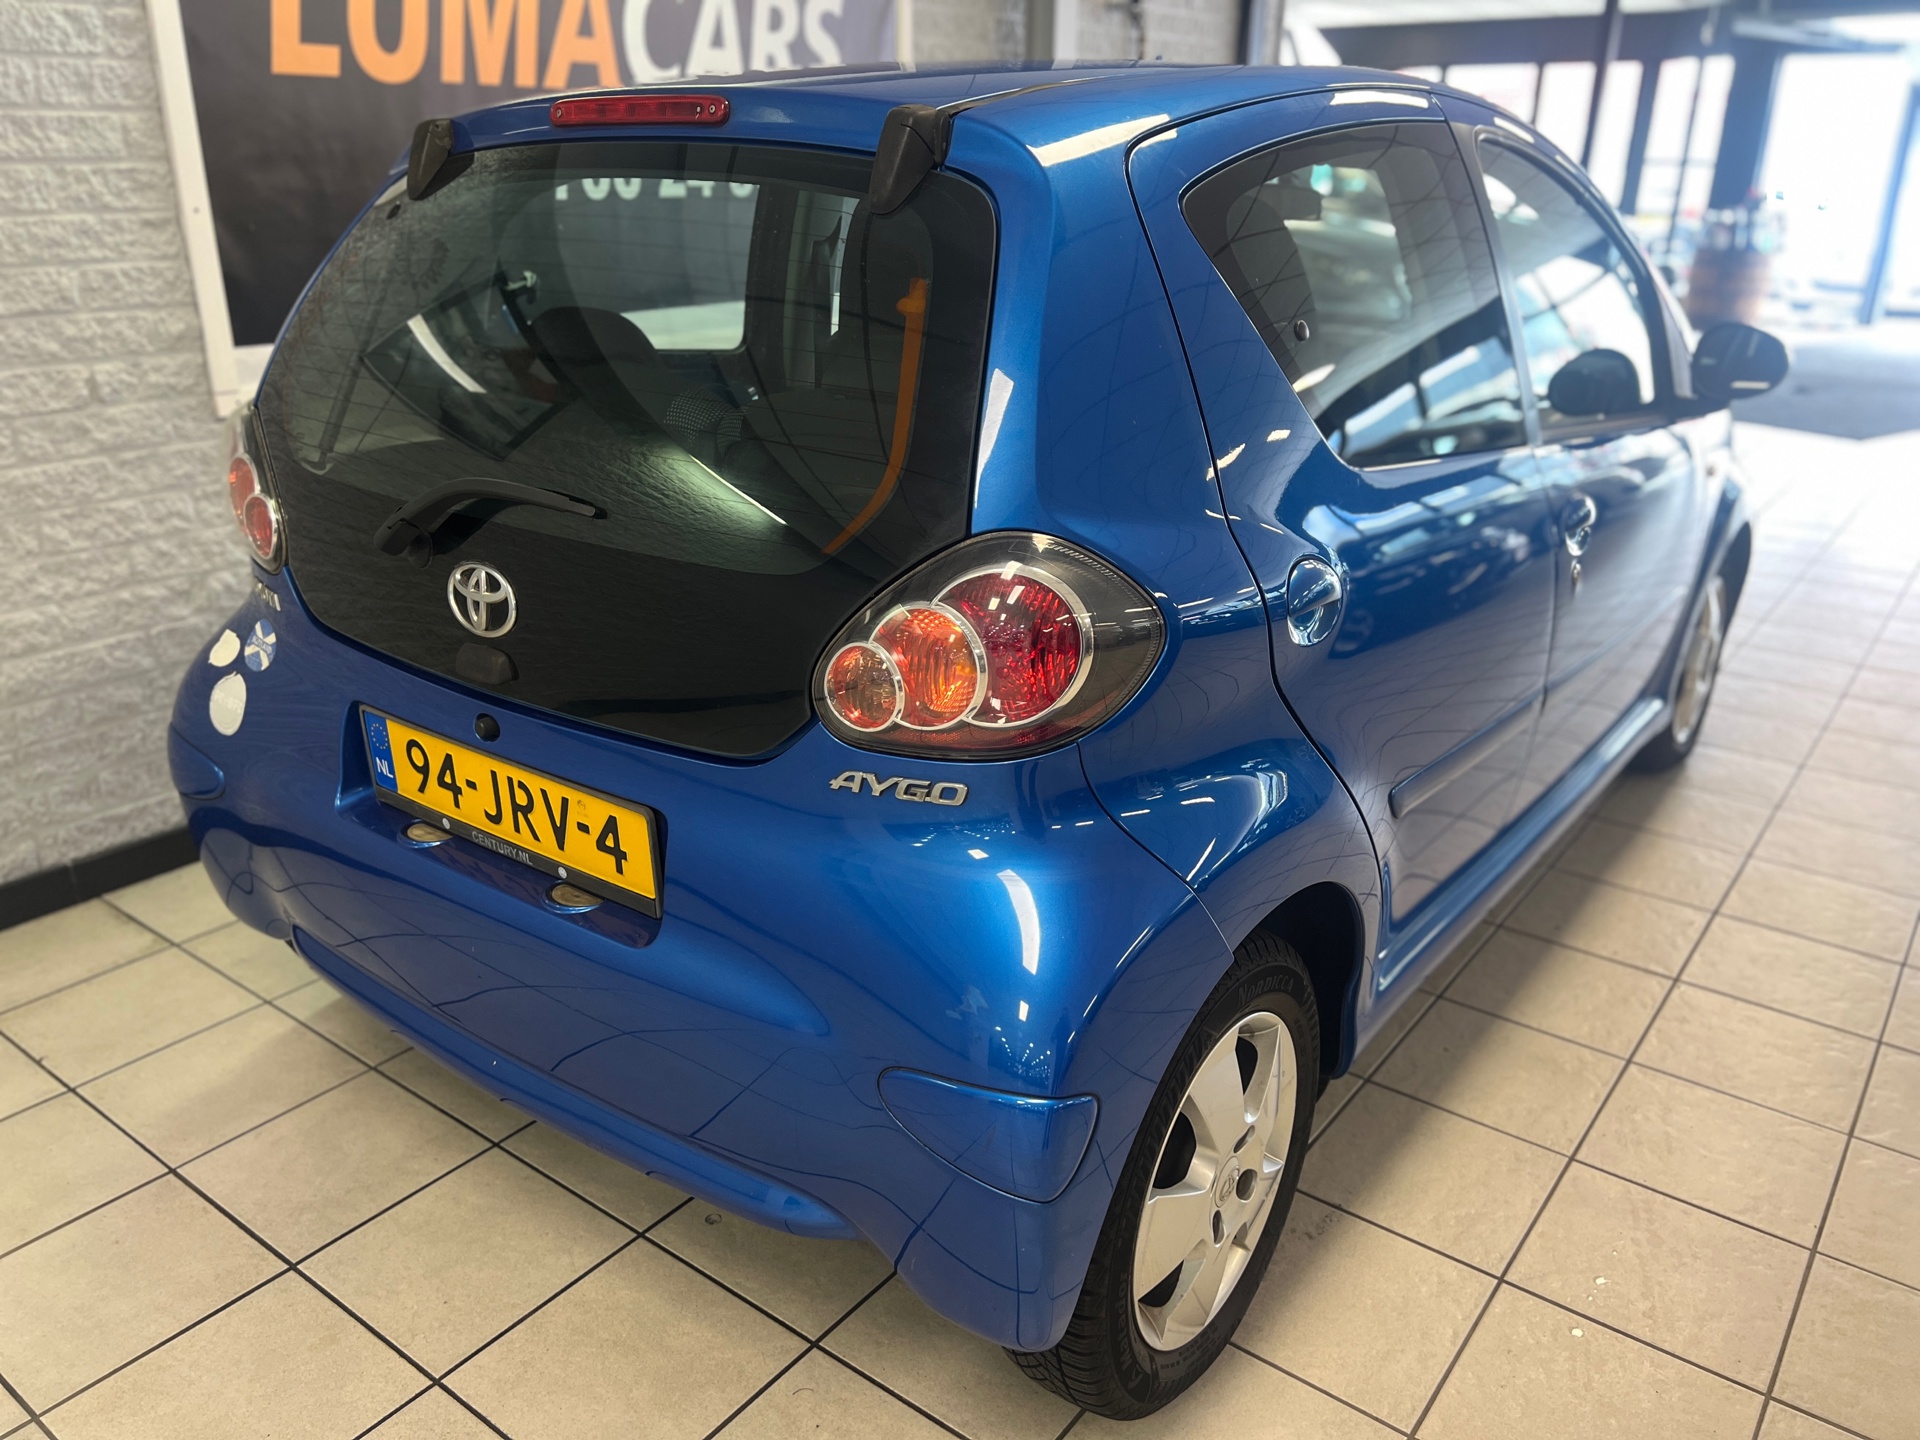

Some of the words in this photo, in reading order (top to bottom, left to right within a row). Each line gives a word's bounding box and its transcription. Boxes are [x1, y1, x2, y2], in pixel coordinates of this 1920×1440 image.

[375, 756, 394, 779] NL
[829, 770, 969, 806] AYGO
[405, 738, 628, 875] 94-JRV-4
[472, 831, 533, 866] CENTURY.NL
